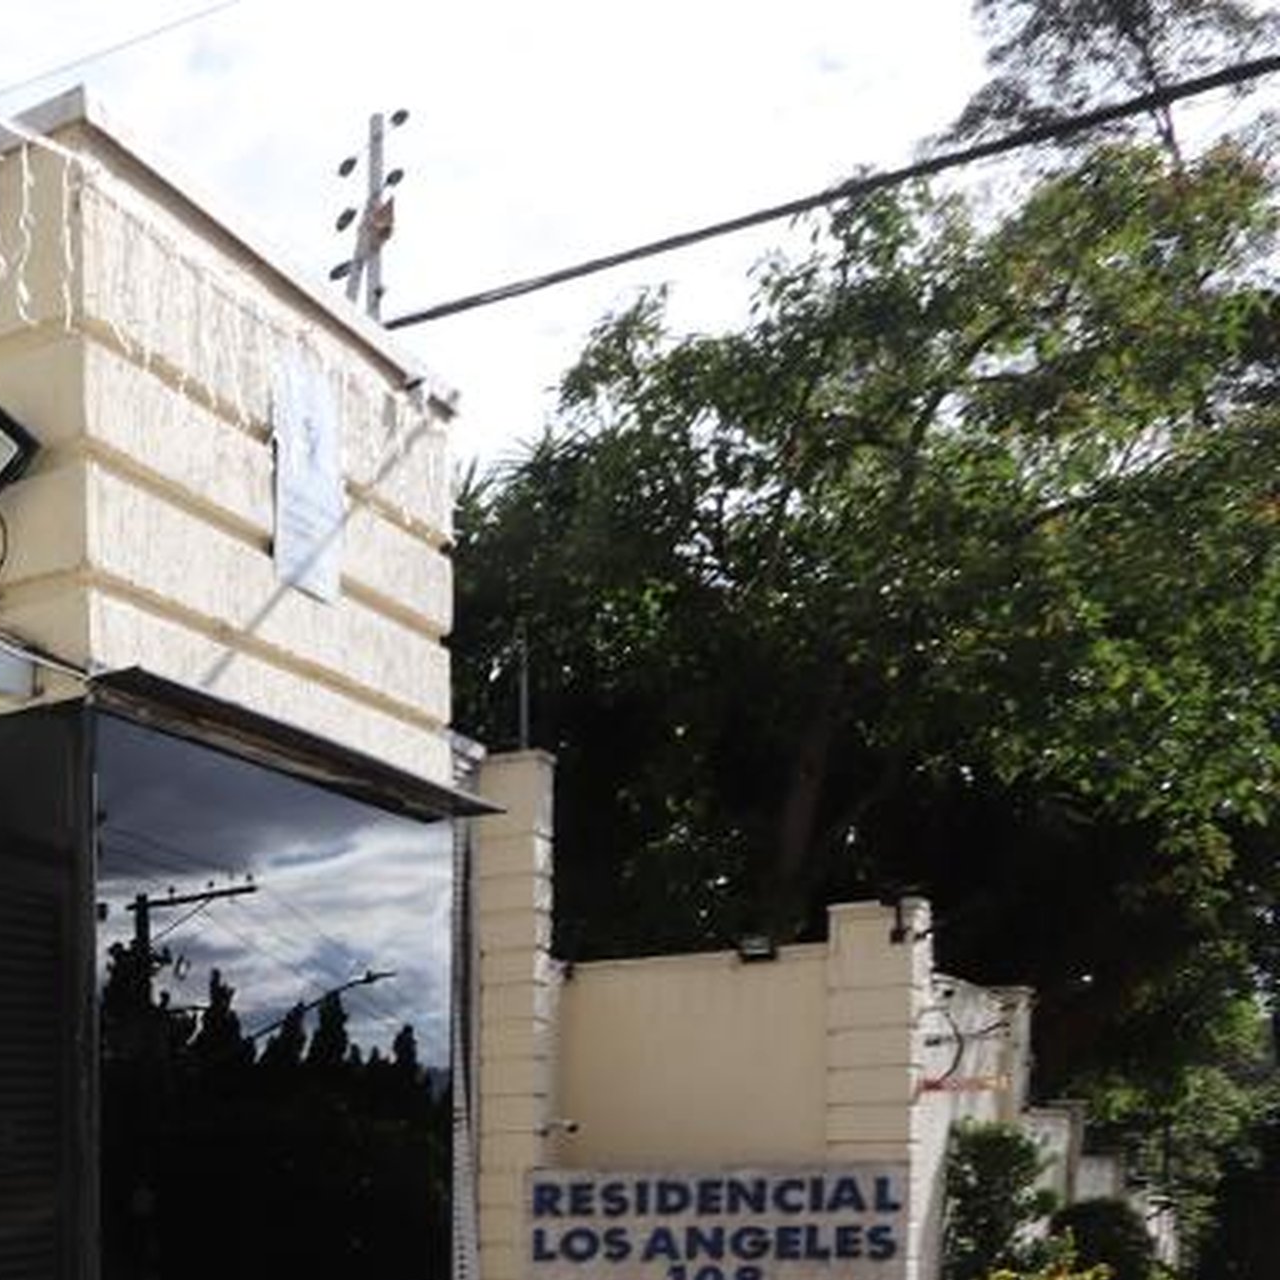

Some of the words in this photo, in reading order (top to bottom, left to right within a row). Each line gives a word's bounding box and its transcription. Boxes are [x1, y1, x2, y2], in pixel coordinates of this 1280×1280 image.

[532, 1176, 901, 1217] RESIDENCIAL
[532, 1226, 633, 1263] LOS
[641, 1224, 898, 1261] ANGELES
